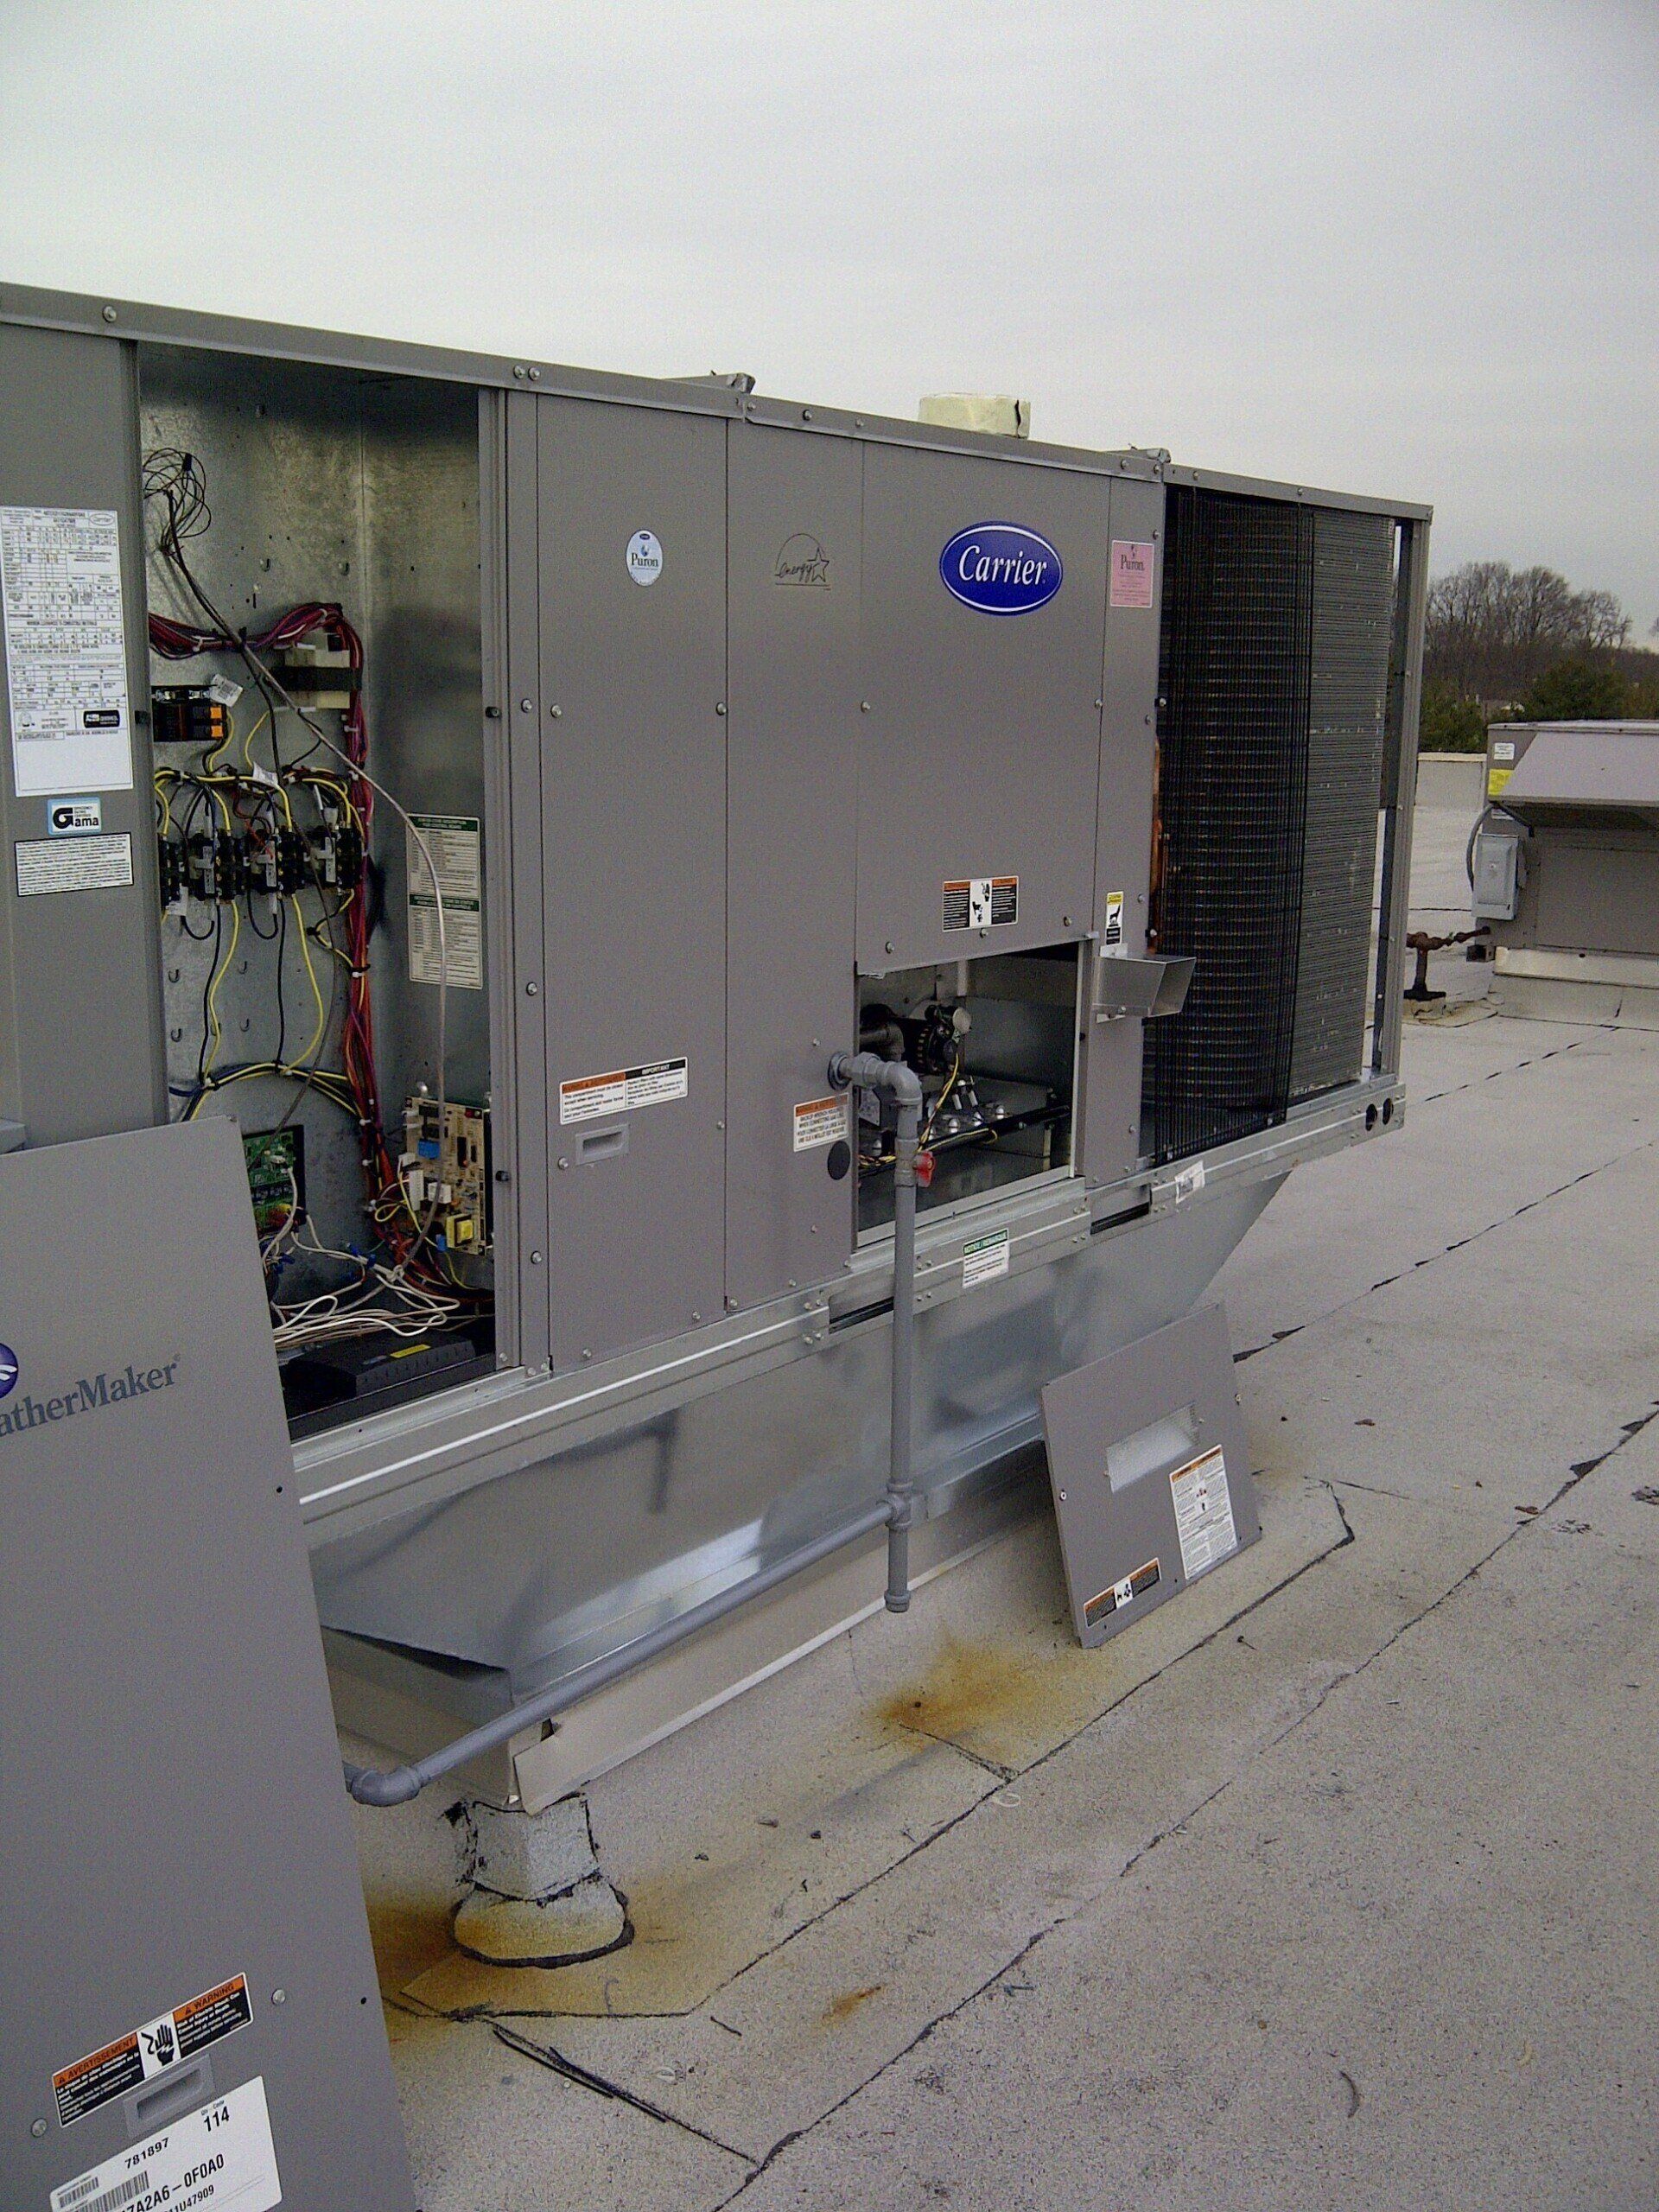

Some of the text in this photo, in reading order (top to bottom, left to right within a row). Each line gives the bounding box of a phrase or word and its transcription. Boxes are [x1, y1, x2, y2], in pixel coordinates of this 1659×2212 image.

[632, 552, 658, 567] Puron
[958, 545, 1048, 585] Carrier
[194, 1983, 234, 2009] WARNING
[203, 2105, 230, 2133] 114
[124, 2138, 169, 2170] 781897
